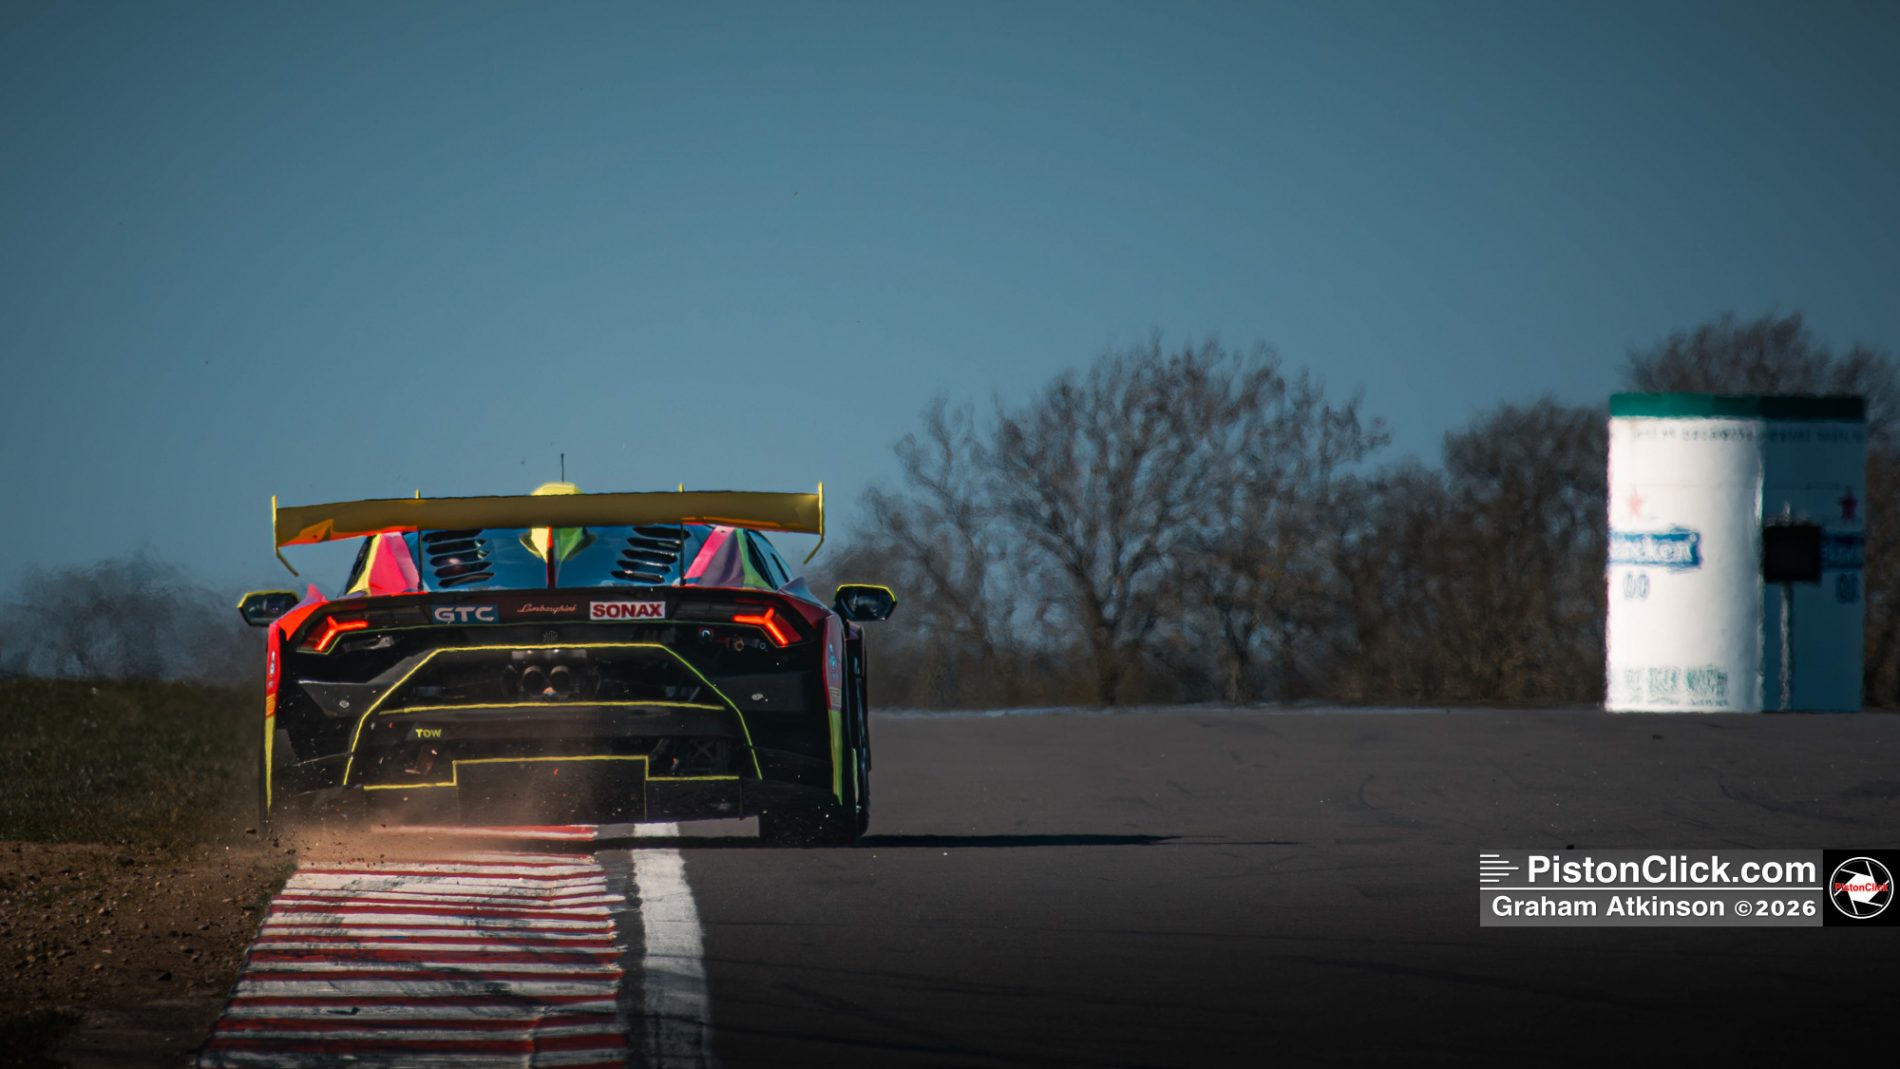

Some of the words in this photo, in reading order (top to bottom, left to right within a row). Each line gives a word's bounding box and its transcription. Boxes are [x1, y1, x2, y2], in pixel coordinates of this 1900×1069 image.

[434, 606, 494, 622] GTC
[592, 602, 663, 618] SONAX
[415, 728, 442, 738] TOW
